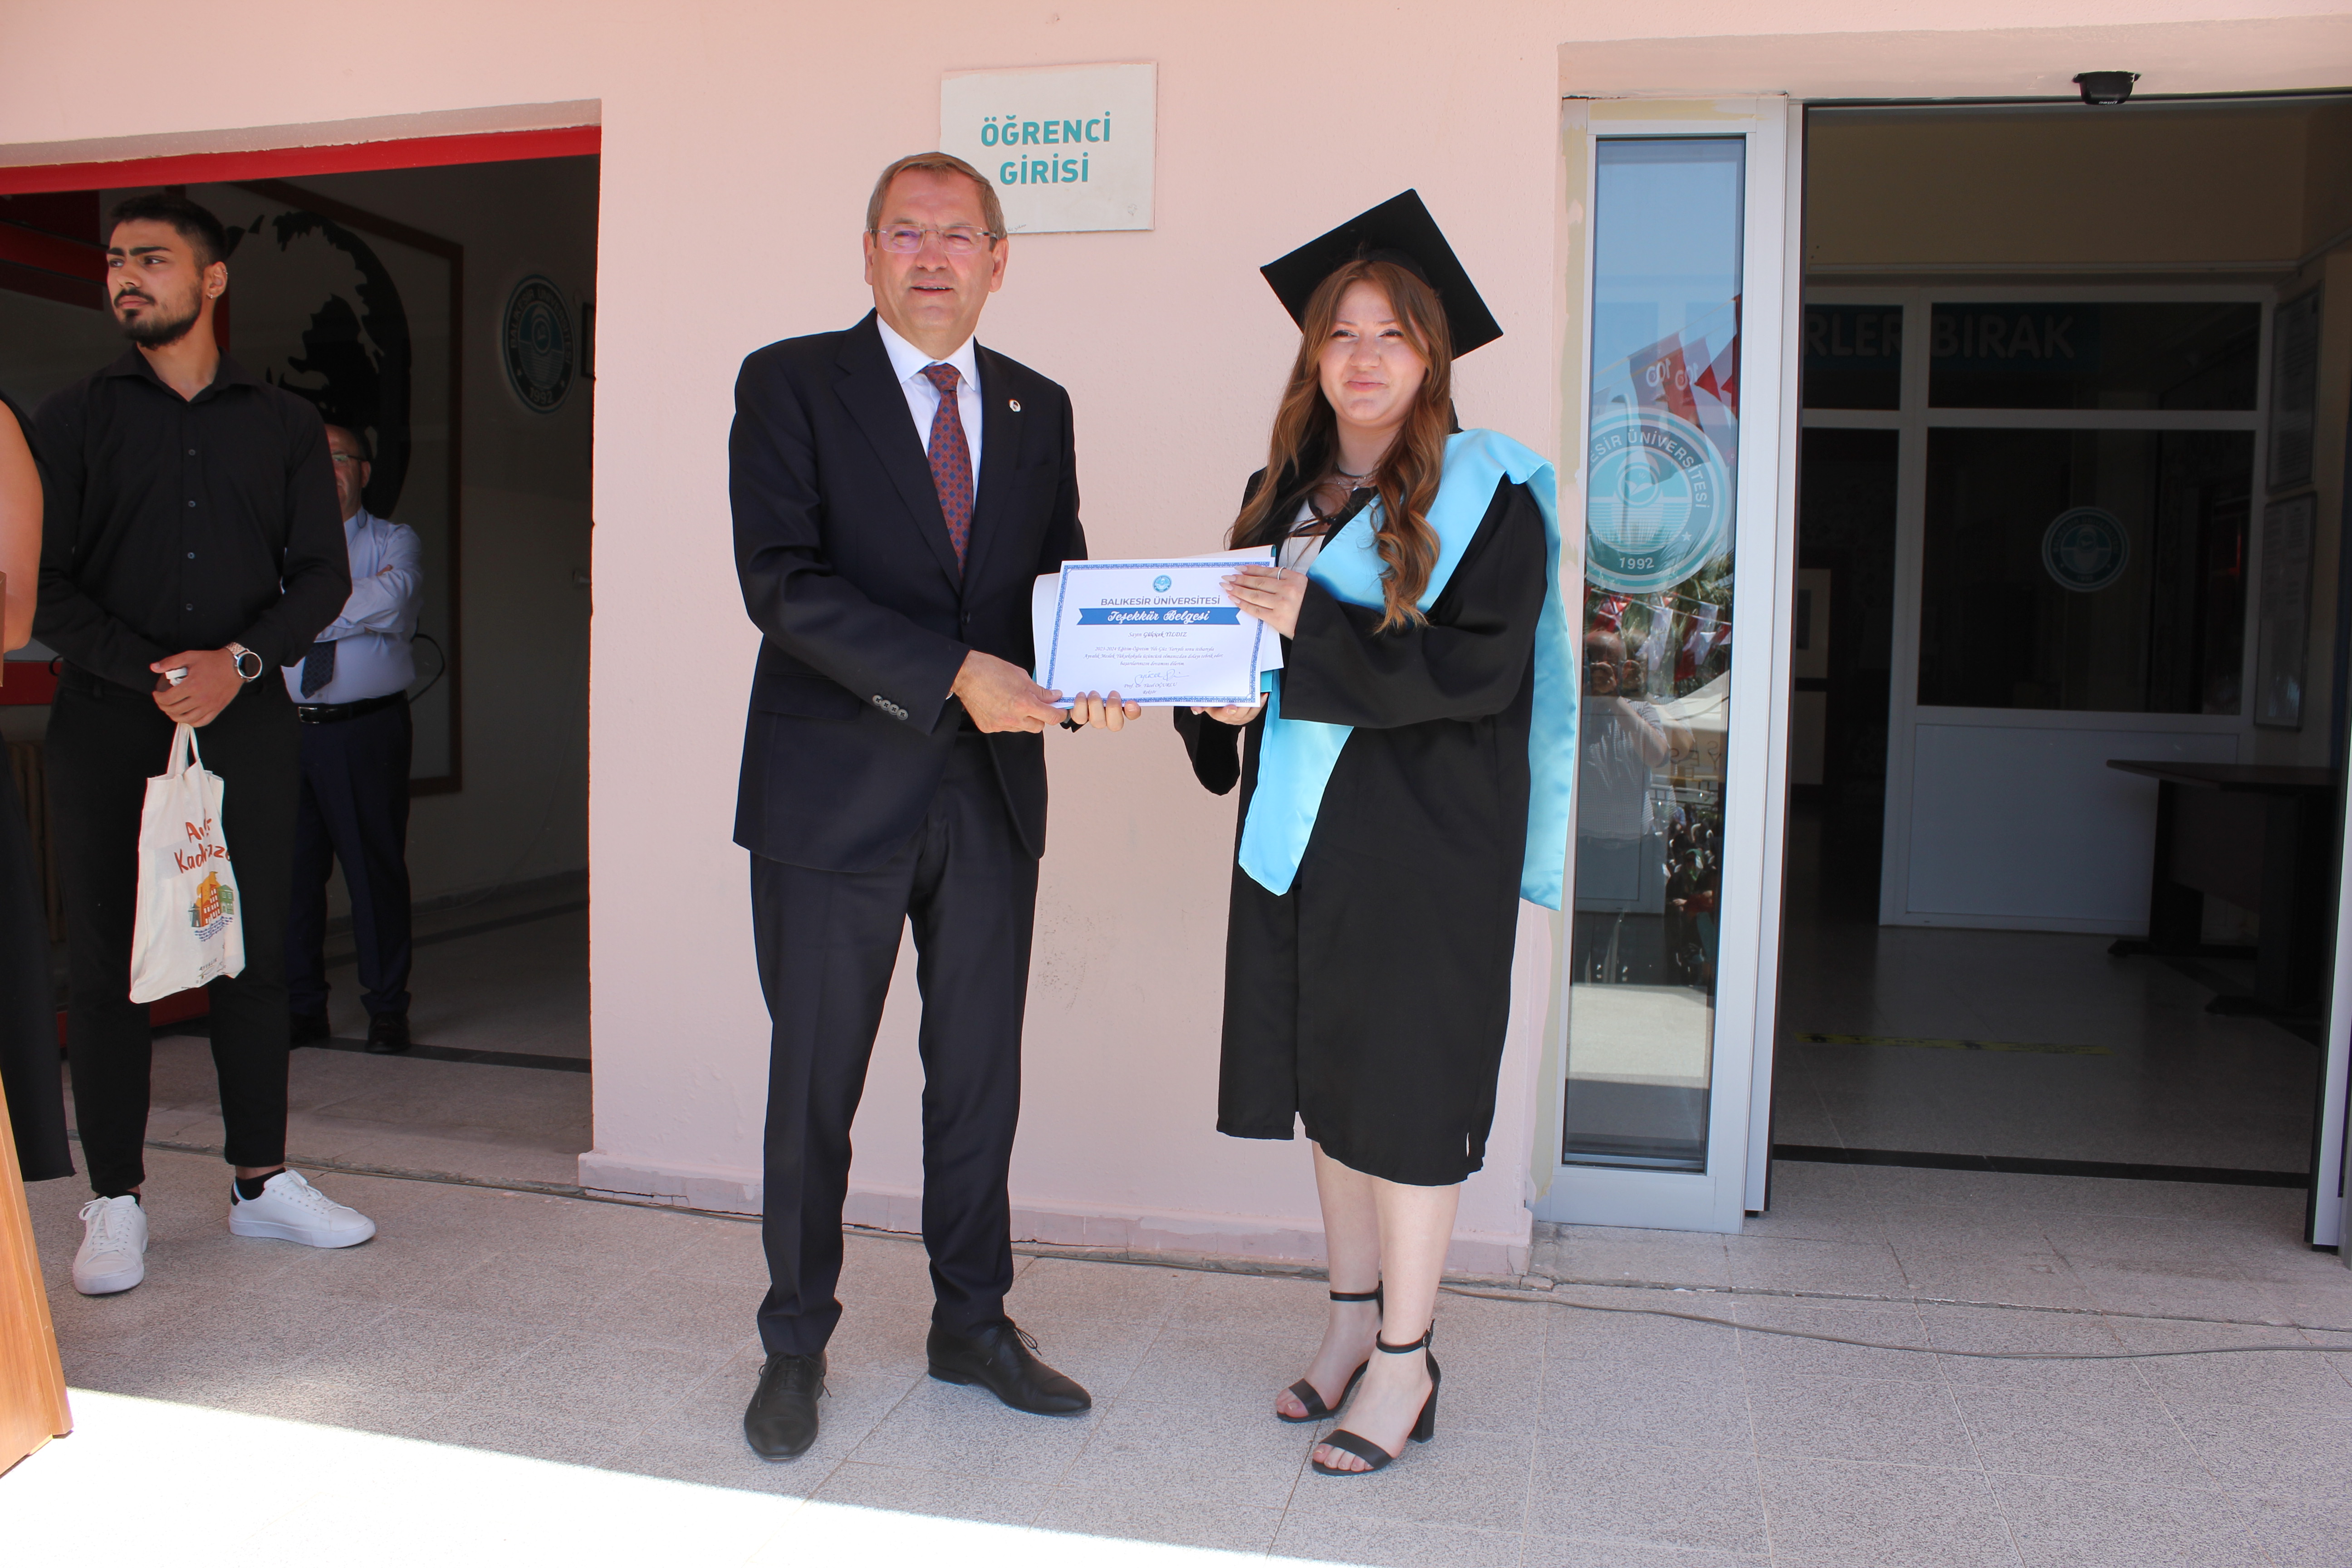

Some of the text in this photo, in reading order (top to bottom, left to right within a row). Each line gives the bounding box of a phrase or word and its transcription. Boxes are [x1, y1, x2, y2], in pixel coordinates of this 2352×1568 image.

[981, 111, 1111, 147] ÖĞRENCİ
[1000, 152, 1089, 185] GİRİSİ
[1931, 313, 2075, 359] BIRAK
[529, 387, 554, 404] 1992
[1590, 429, 1710, 508] ESİR ÜNİVERSİTESİ
[1619, 557, 1655, 570] 1992
[1101, 595, 1220, 606] BALIKESİR ÜNİVERSİTESİ
[1107, 610, 1210, 624] Teşekkür Belgesi
